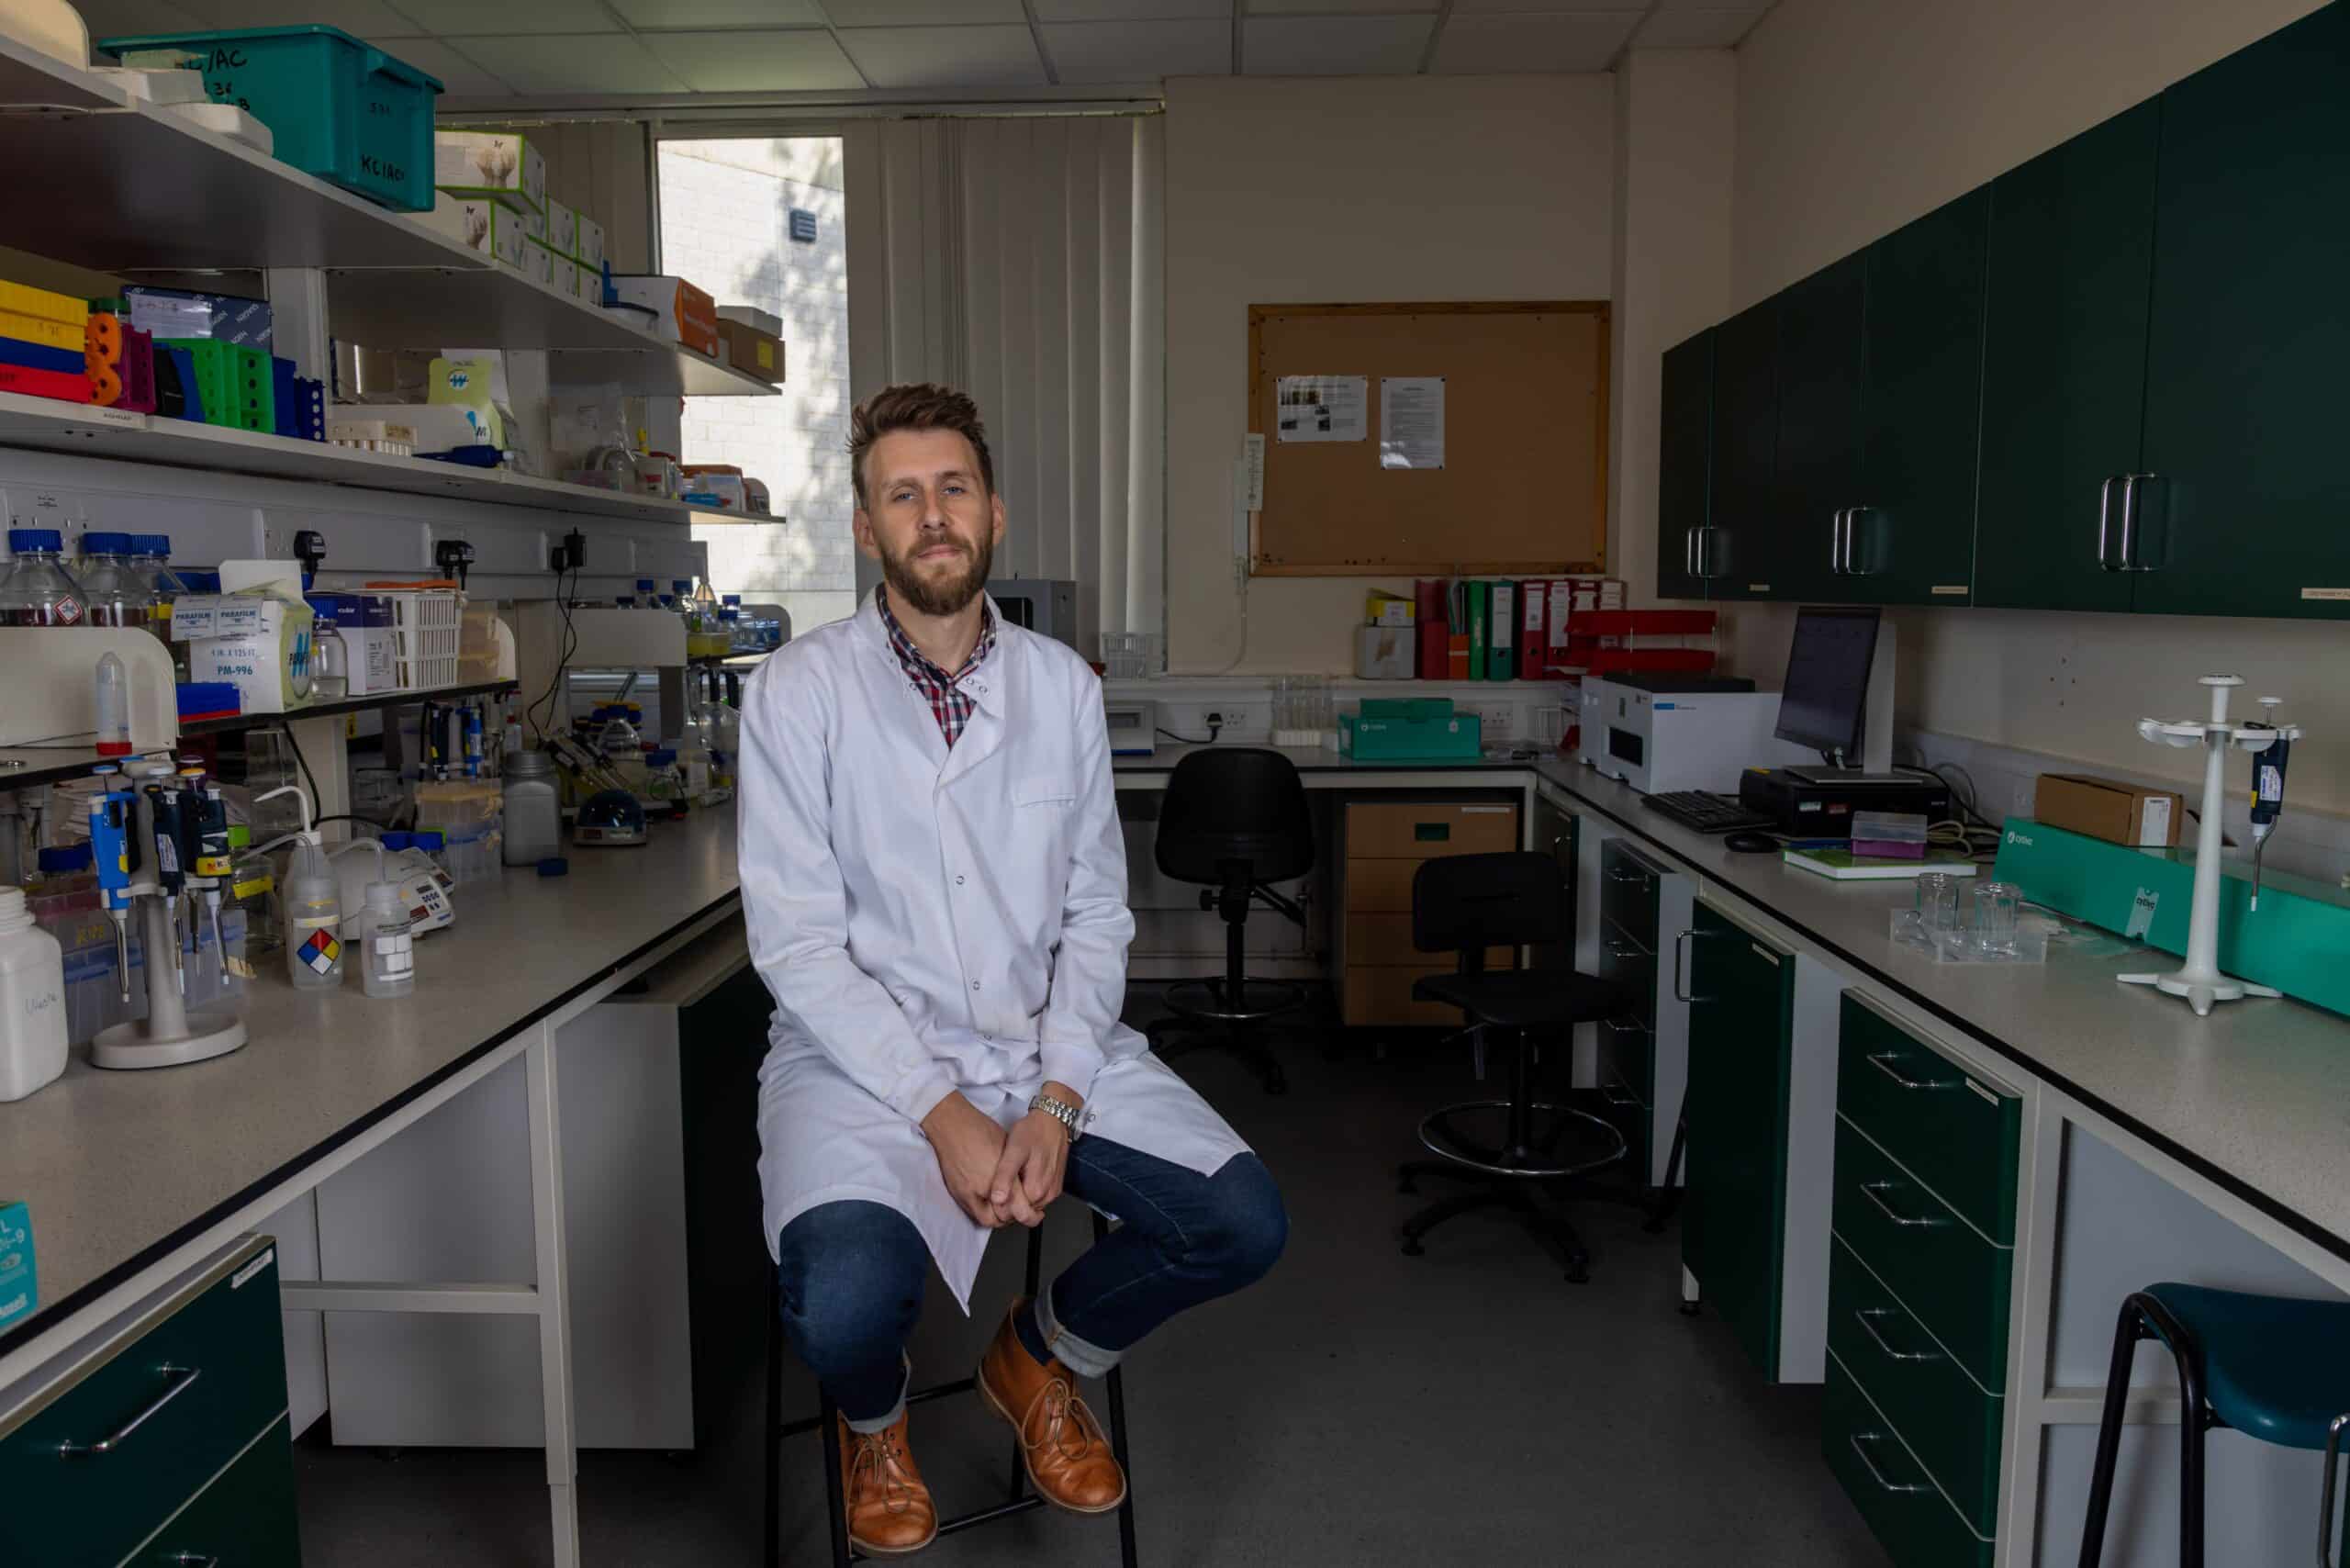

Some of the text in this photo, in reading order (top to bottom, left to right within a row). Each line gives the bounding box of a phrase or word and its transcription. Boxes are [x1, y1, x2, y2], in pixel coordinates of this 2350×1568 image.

[175, 611, 211, 621] PARAFILM
[220, 610, 256, 619] PARAFILM
[218, 665, 253, 676] PM-996
